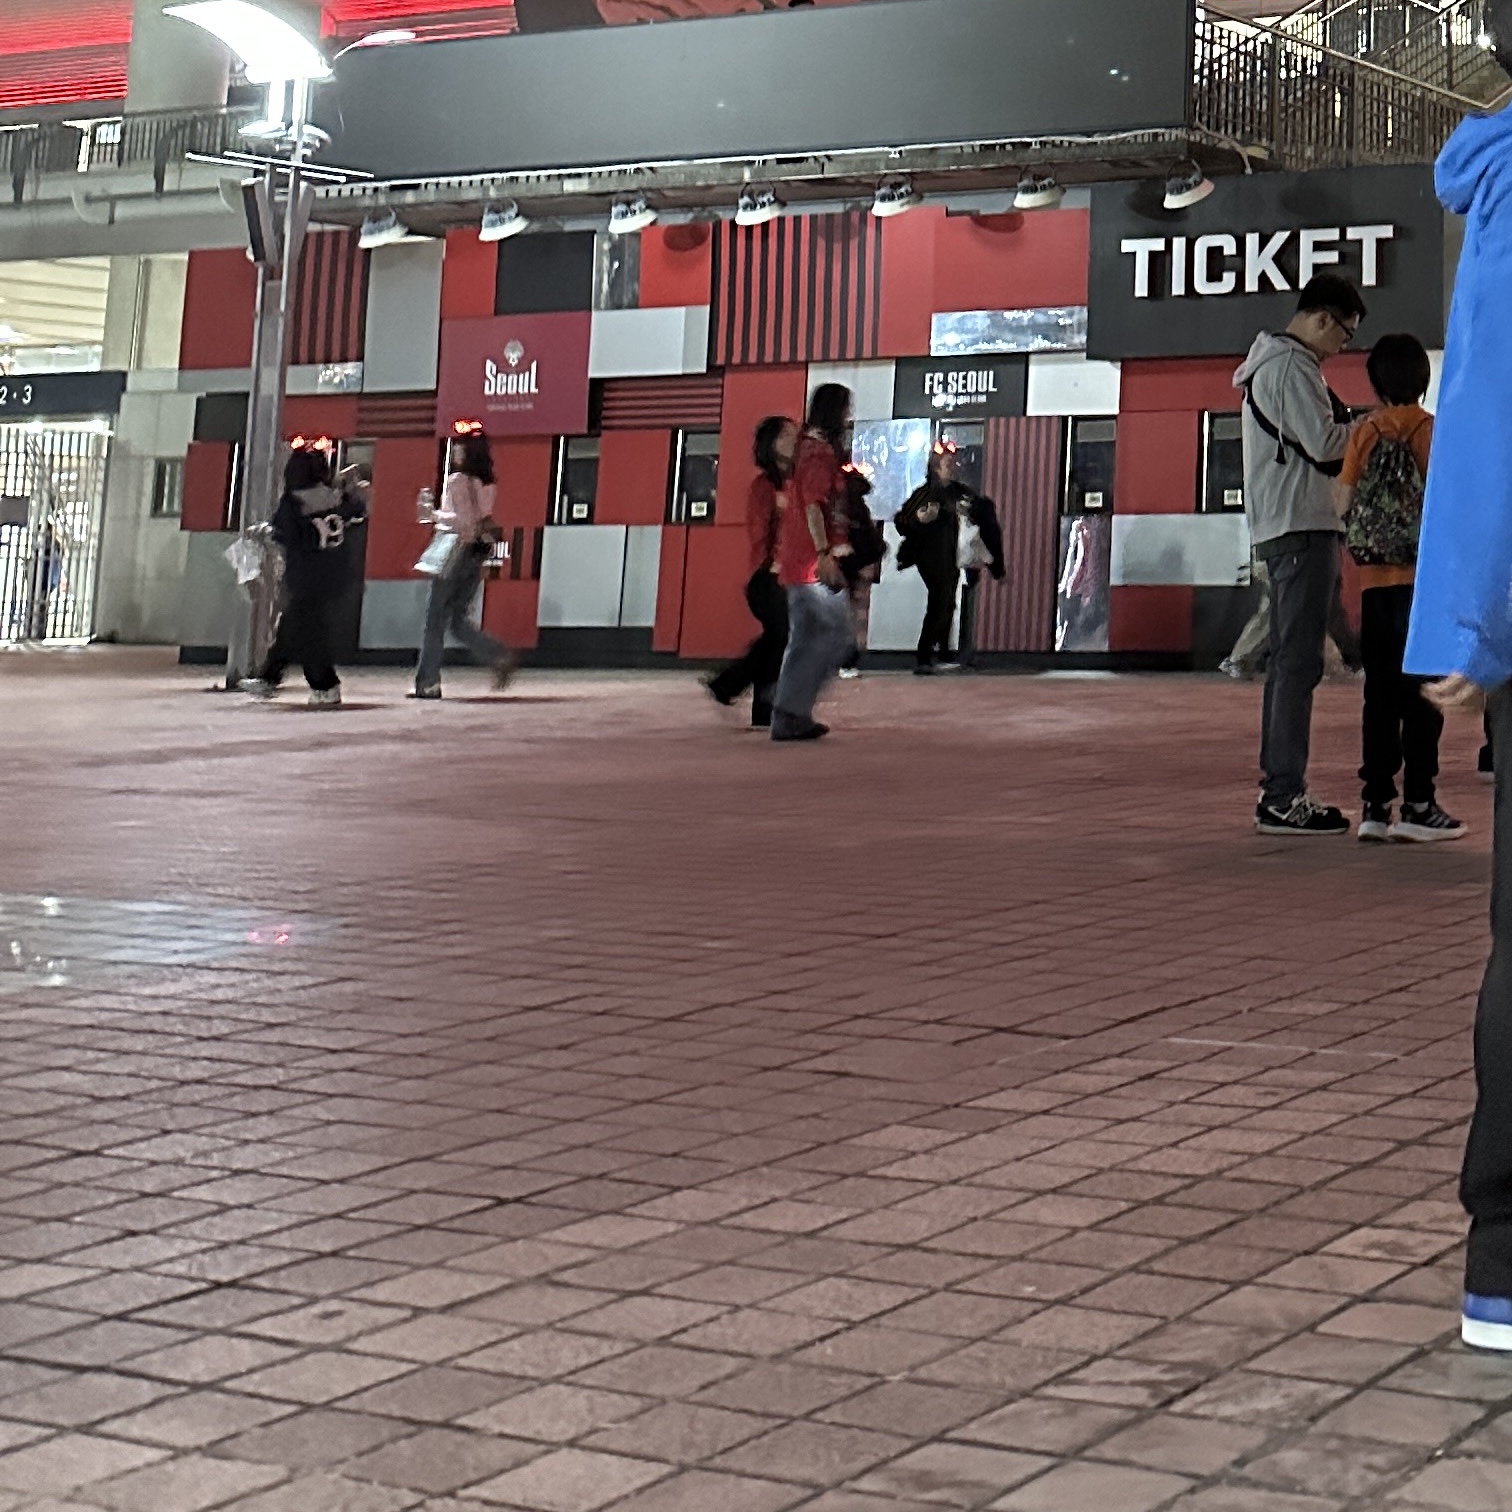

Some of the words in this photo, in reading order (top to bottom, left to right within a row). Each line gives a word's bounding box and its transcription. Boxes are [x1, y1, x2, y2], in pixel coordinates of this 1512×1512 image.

[1119, 224, 1394, 299] TICKET
[924, 372, 944, 395] FC
[947, 370, 998, 394] SEOUL
